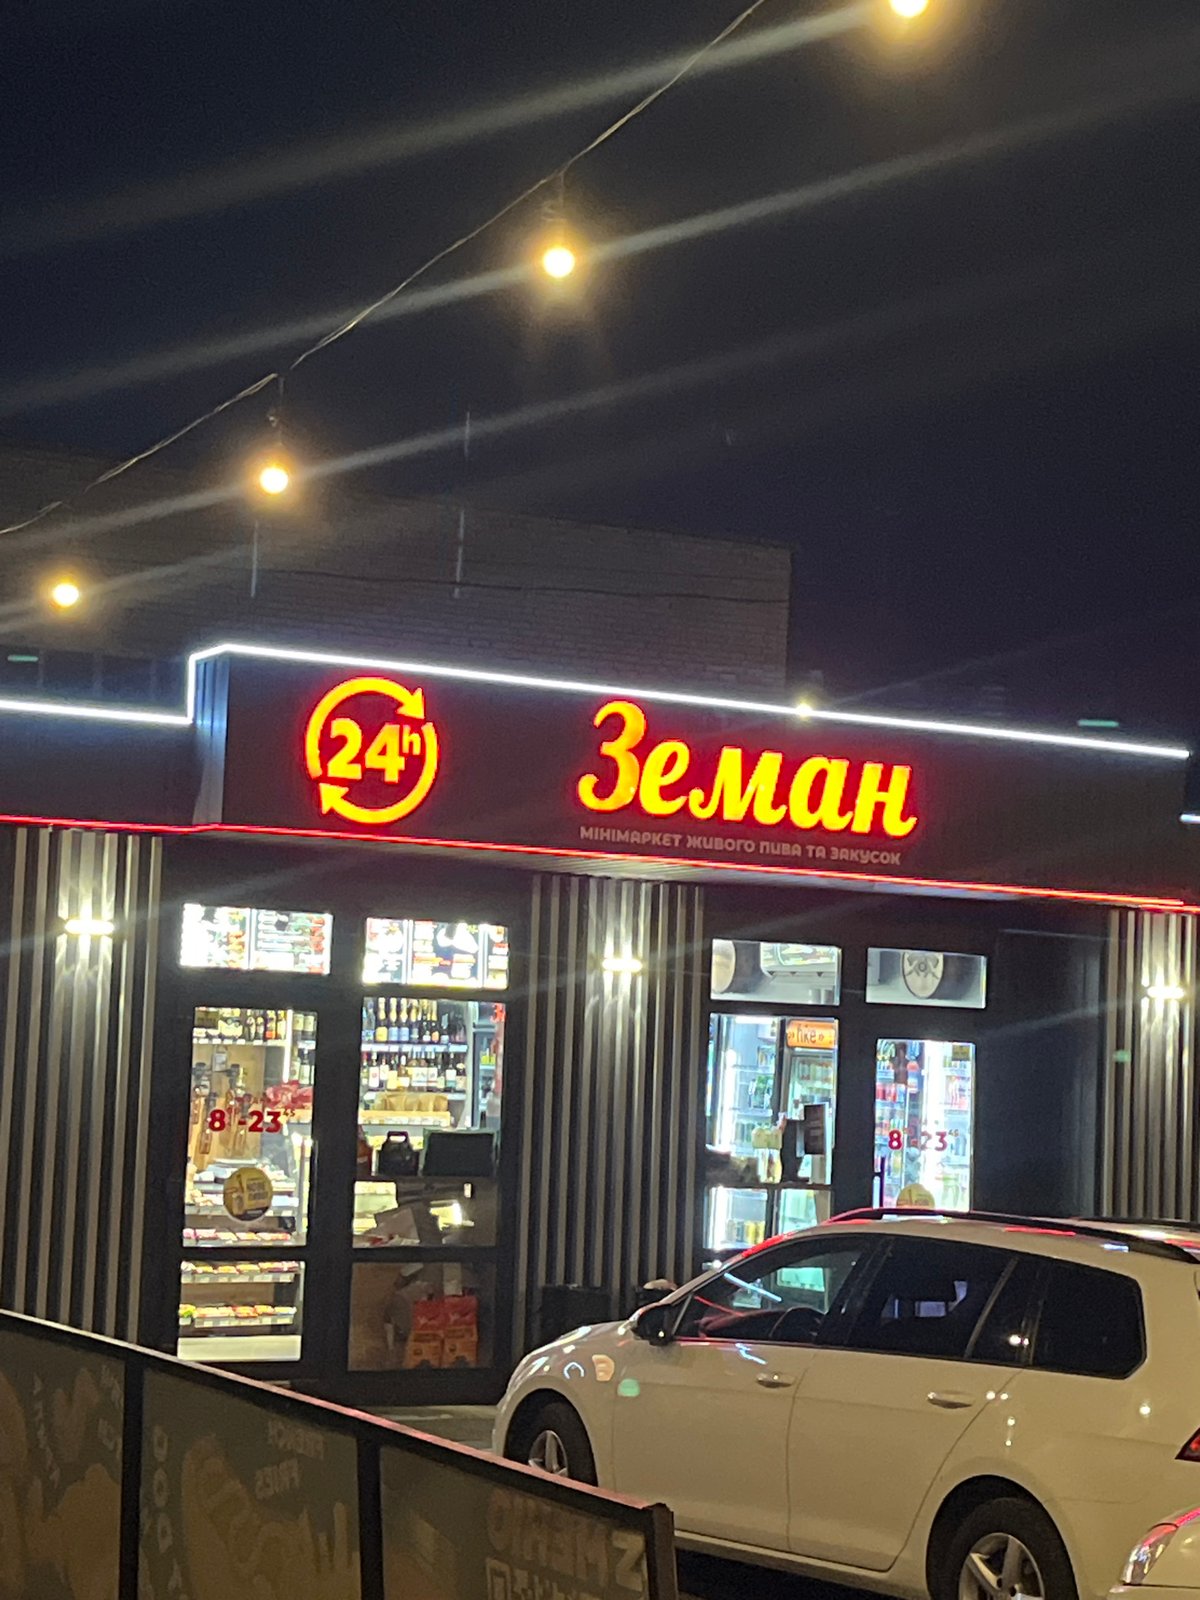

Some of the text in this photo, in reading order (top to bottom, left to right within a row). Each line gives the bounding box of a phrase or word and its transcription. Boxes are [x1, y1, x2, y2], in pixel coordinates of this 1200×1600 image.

[579, 700, 918, 837] Земан
[580, 825, 901, 866] МІНІМАРКЕТ ЖИВОГО ПИВА ТА ЗАКУСОК
